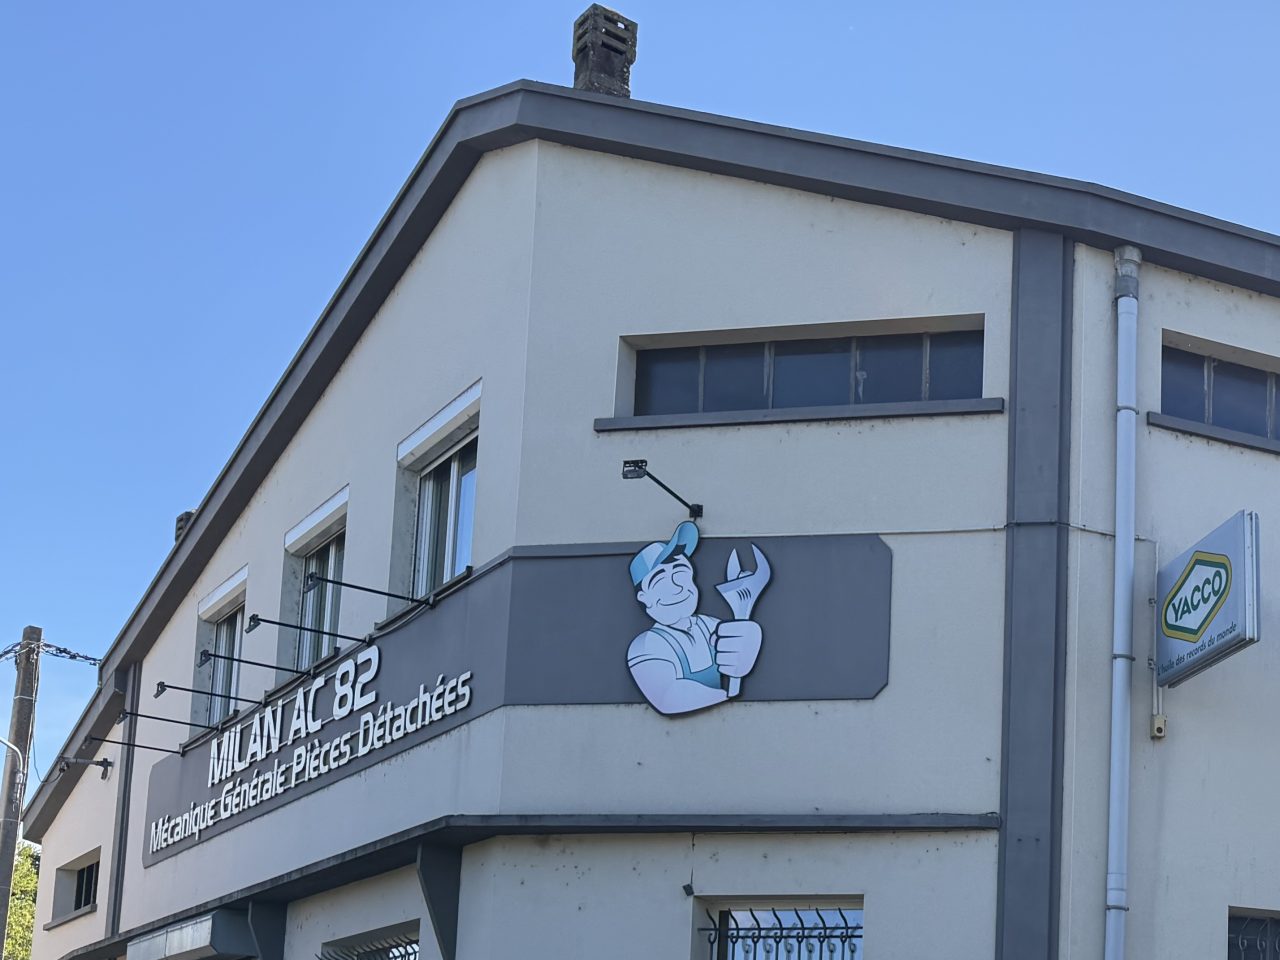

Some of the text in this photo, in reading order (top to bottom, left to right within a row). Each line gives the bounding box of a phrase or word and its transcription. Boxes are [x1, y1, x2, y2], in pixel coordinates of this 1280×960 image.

[1171, 569, 1223, 624] YACCO
[1175, 653, 1186, 666] des
[1186, 639, 1207, 660] records
[1207, 634, 1216, 648] du
[1216, 621, 1237, 641] monde
[149, 670, 472, 855] Mécanique Générale Pièces Détachées
[208, 645, 380, 789] MILAN AC 82
